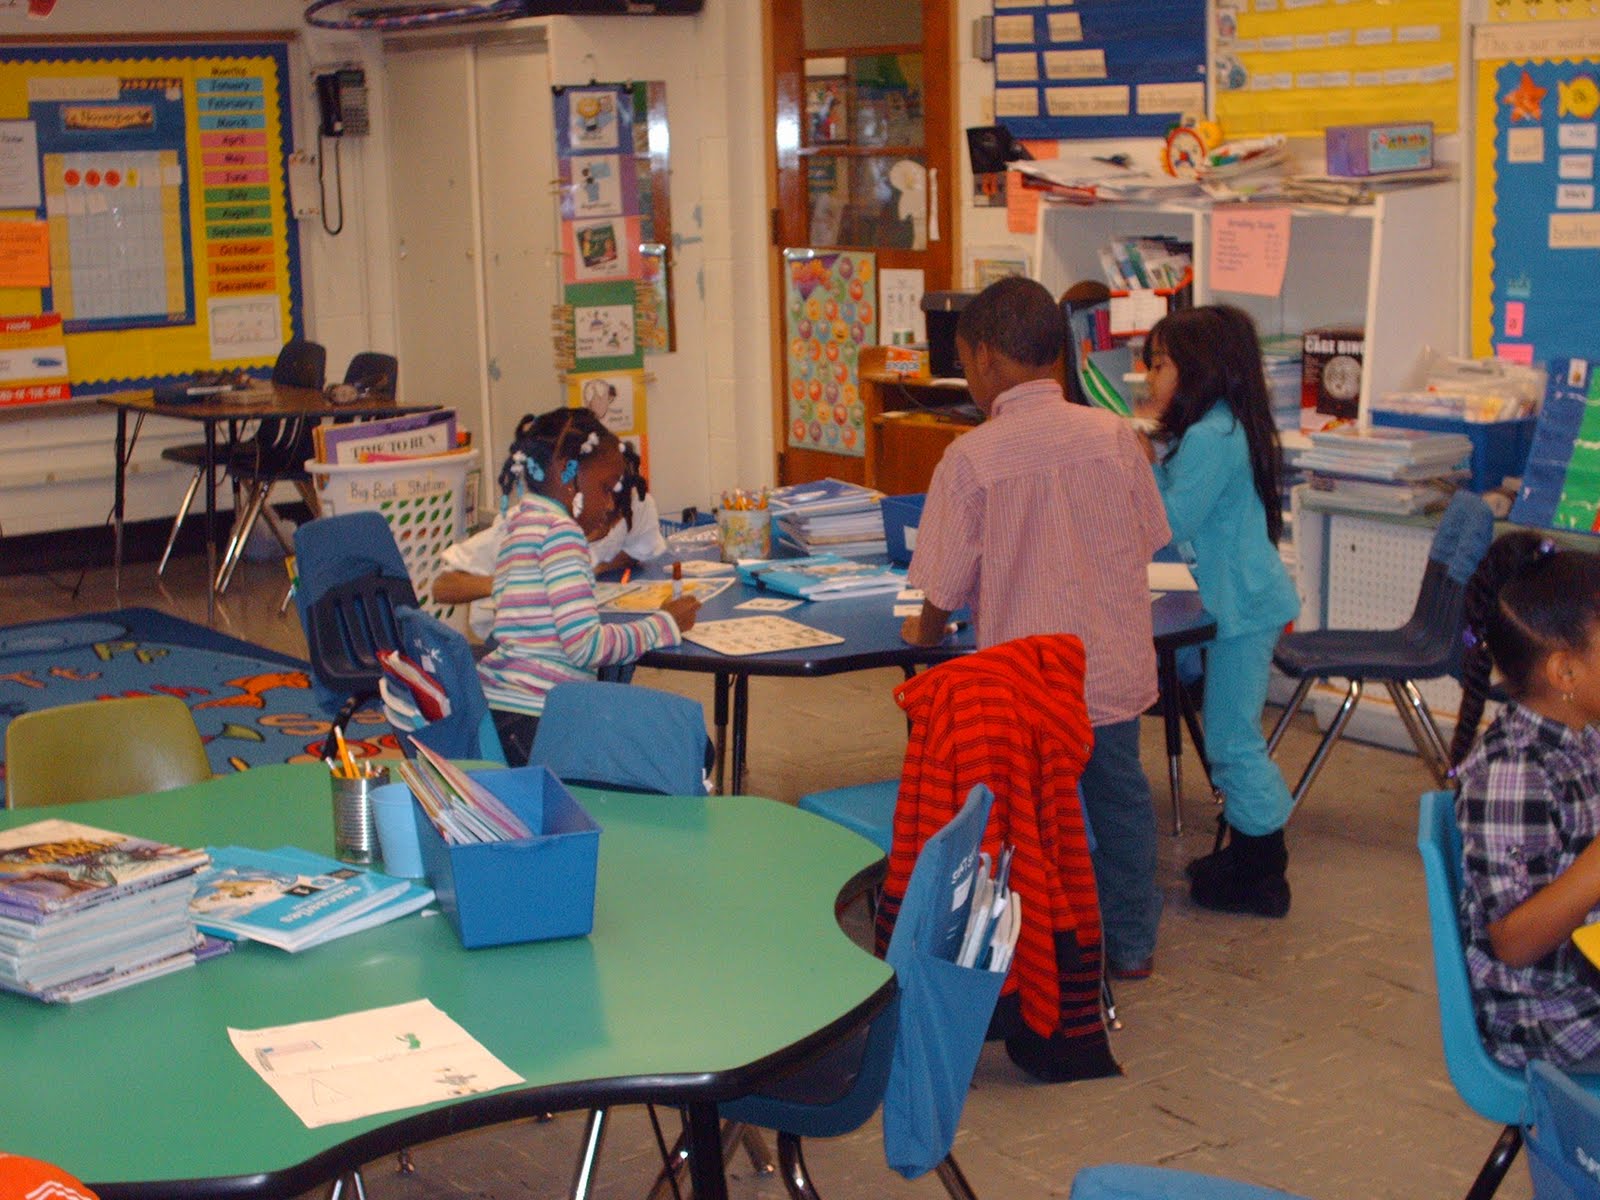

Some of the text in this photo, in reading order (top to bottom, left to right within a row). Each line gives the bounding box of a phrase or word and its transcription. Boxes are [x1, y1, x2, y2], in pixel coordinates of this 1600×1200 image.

[210, 79, 251, 92] January
[207, 97, 254, 111] February
[215, 116, 249, 129] March
[222, 134, 246, 147] April
[223, 153, 246, 165] May
[224, 171, 248, 183] June
[227, 189, 249, 202] July
[222, 208, 256, 221] August
[211, 225, 268, 240] September
[218, 245, 262, 257] October
[215, 262, 267, 274] November
[216, 280, 268, 293] December
[350, 479, 446, 500] Big Book Station
